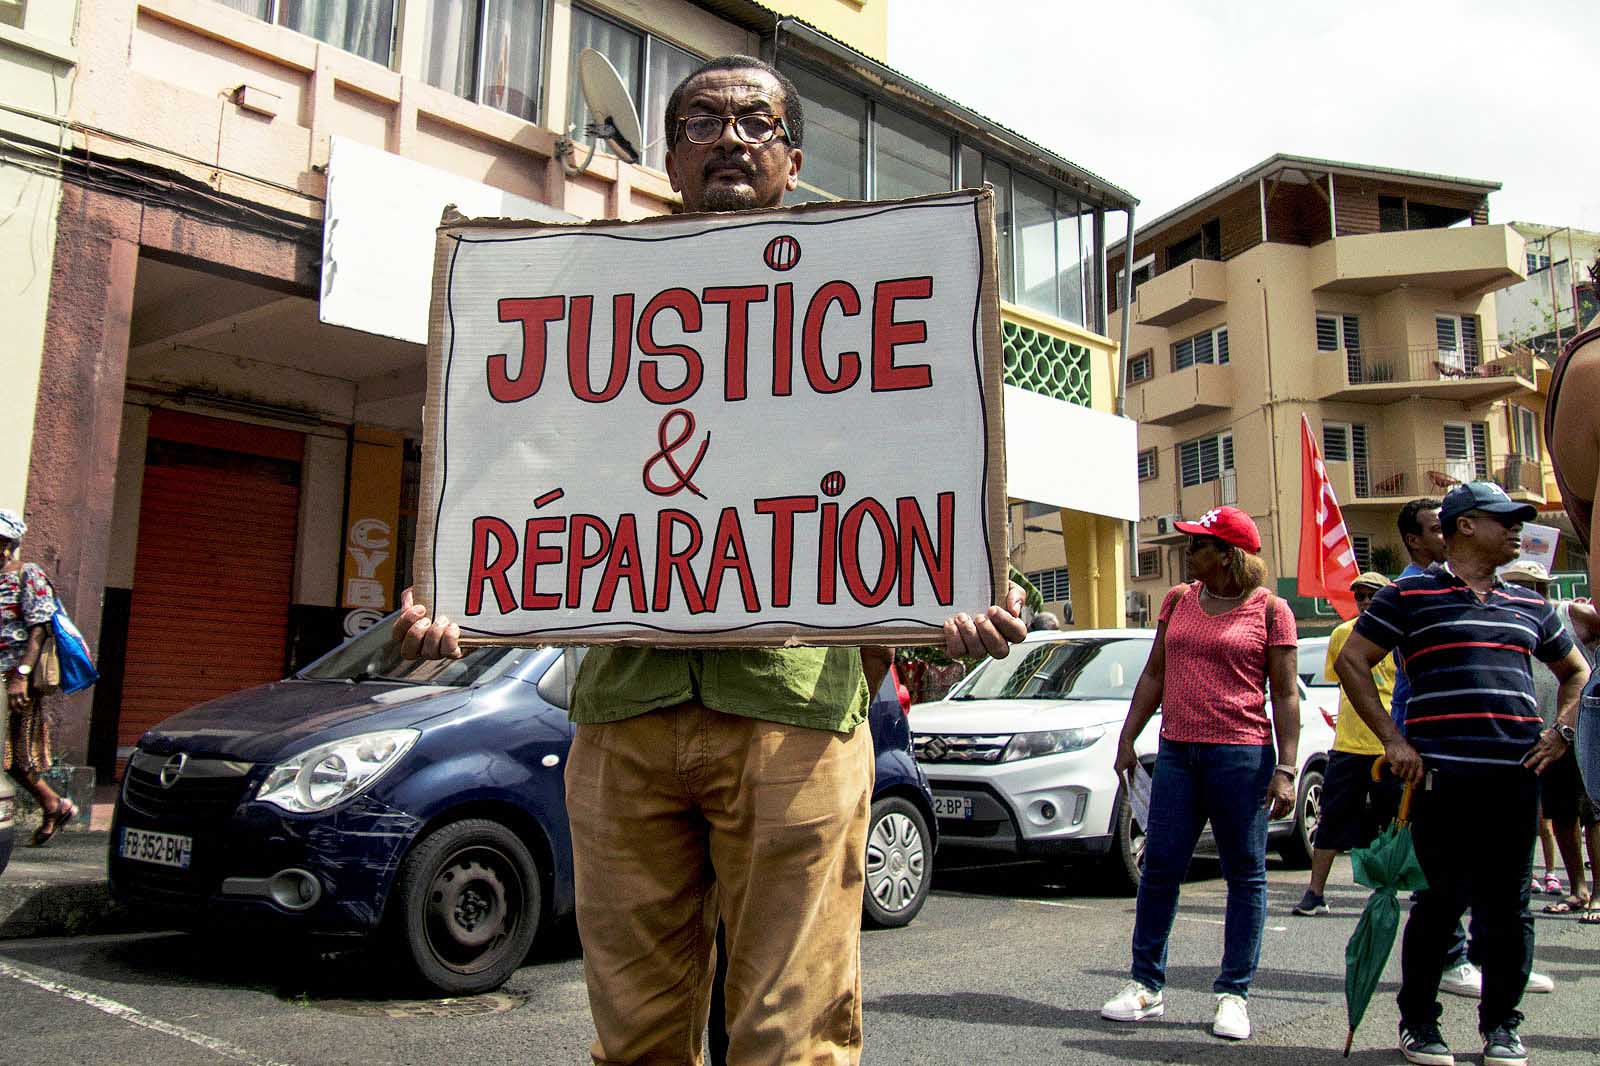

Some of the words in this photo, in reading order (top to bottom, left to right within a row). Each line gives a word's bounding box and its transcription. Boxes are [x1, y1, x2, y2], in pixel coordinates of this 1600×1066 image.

[486, 235, 934, 405] JUSTICE
[643, 408, 710, 500] &
[465, 470, 956, 616] RÉPARATION
